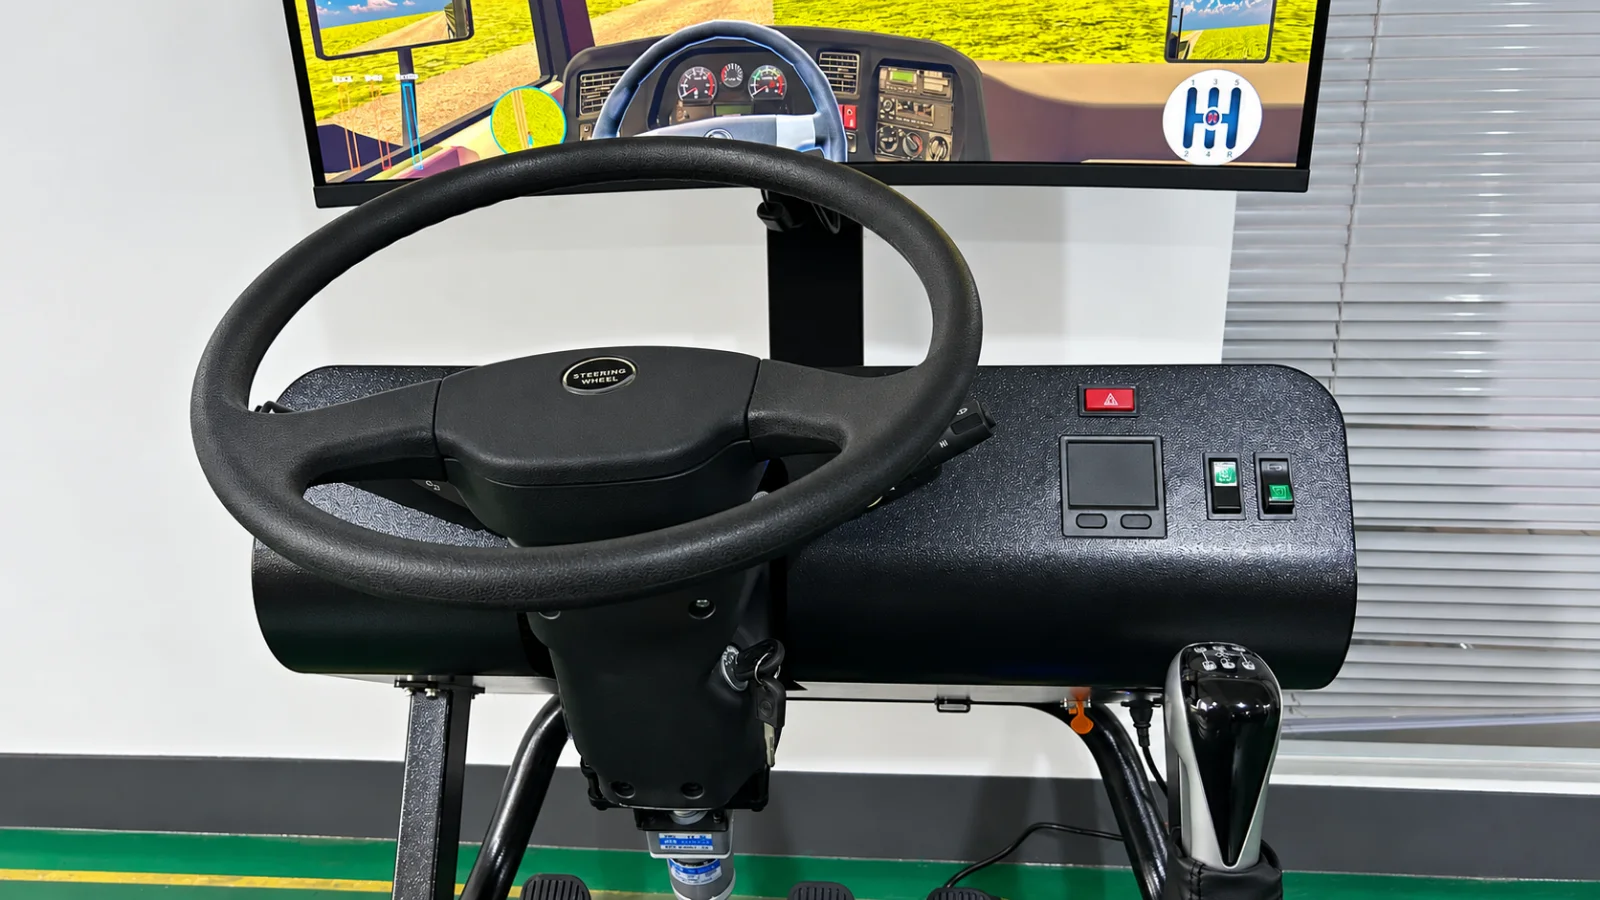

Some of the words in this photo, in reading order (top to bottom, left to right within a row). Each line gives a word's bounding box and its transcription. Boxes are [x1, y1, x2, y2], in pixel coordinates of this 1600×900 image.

[1213, 78, 1218, 86] 3
[1184, 150, 1189, 158] 2
[573, 368, 627, 380] STEERING
[581, 376, 619, 385] WHEEL
